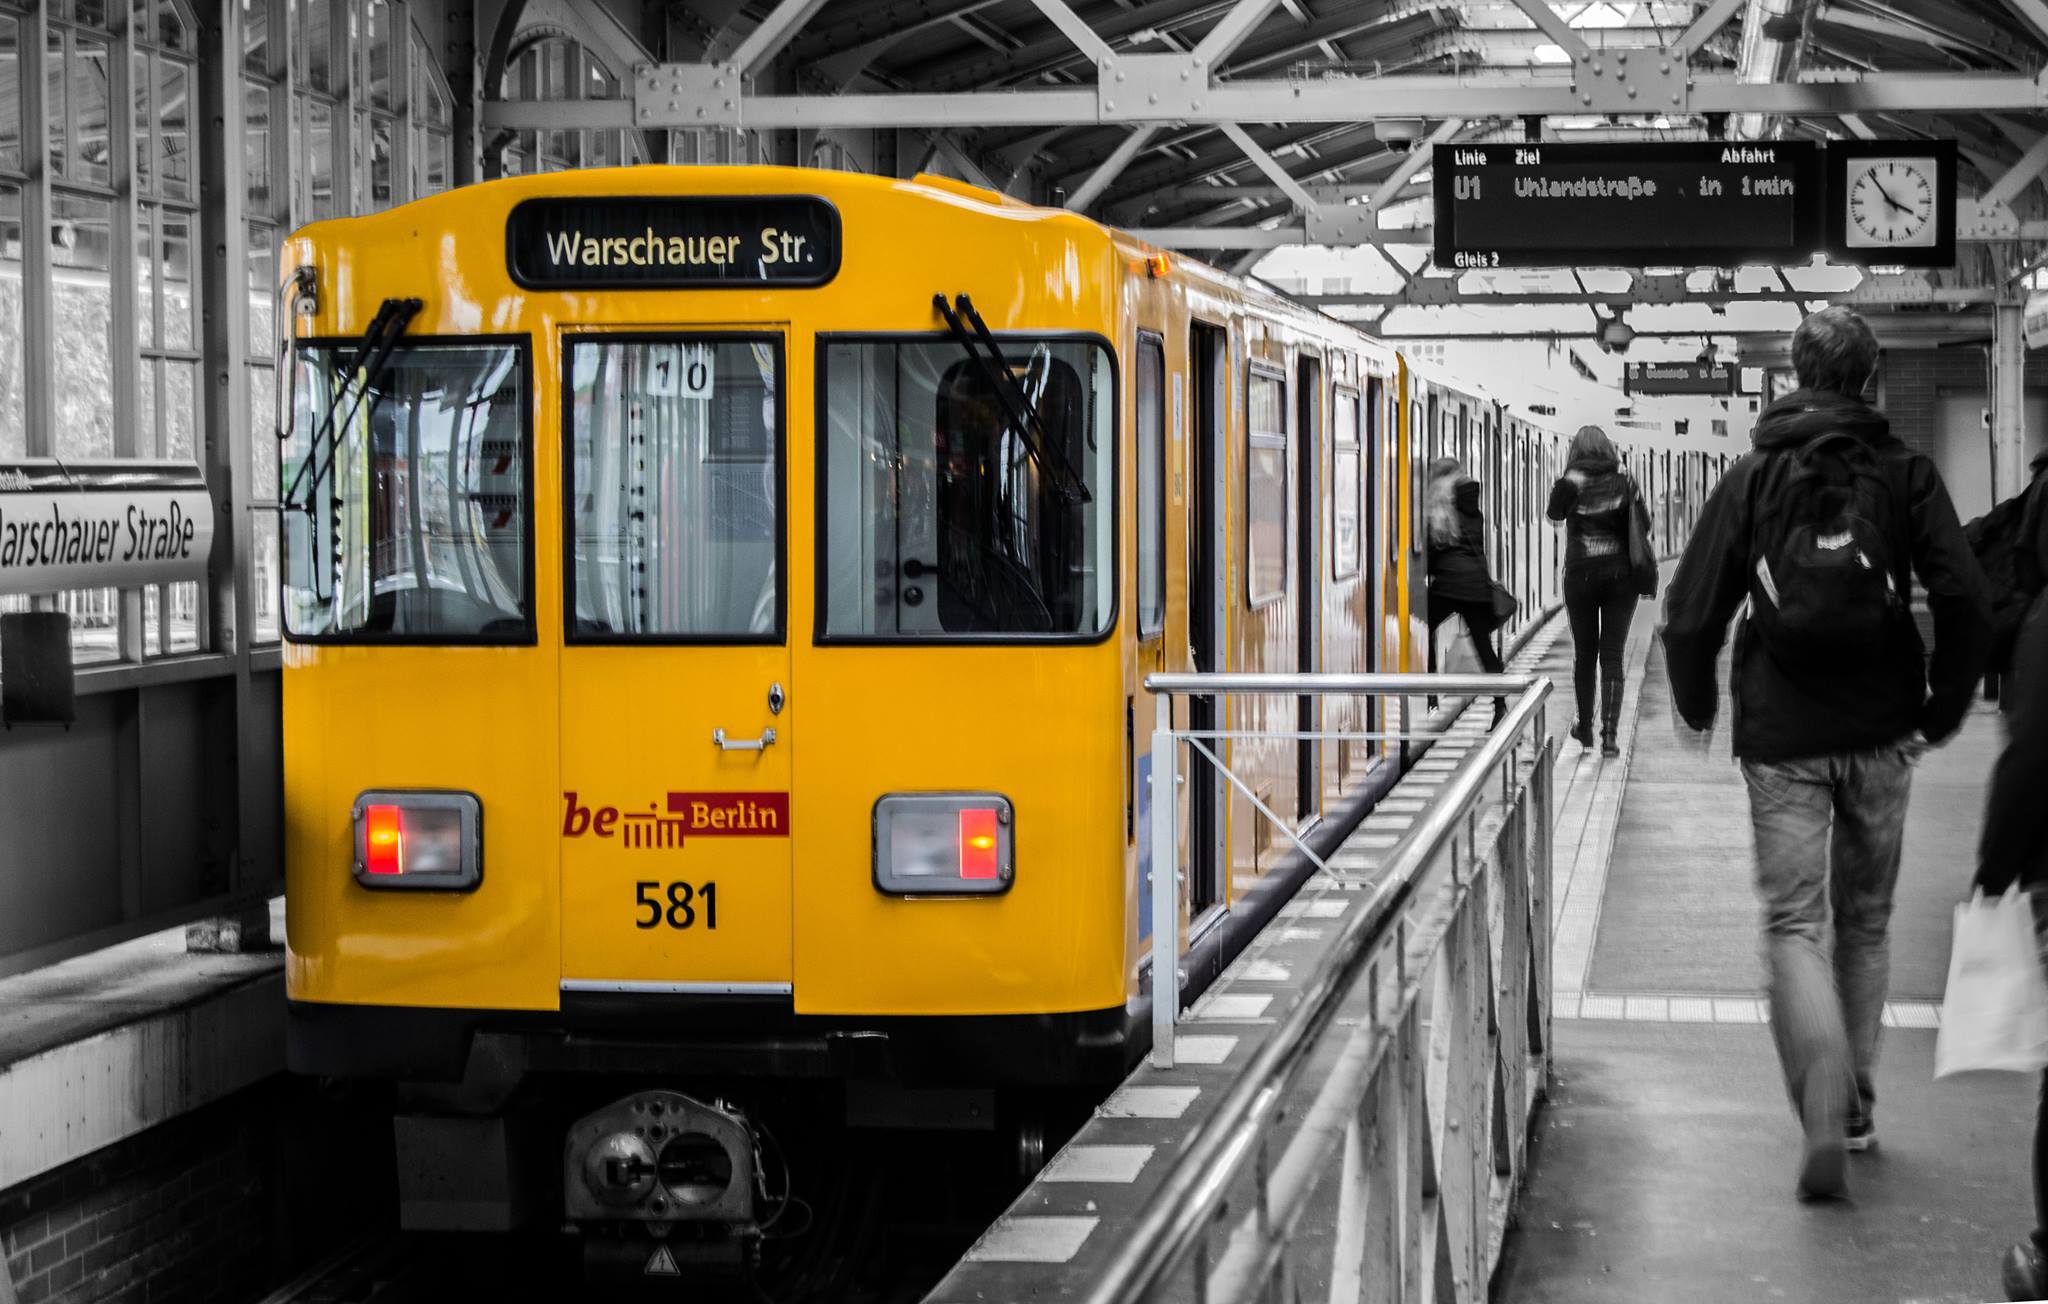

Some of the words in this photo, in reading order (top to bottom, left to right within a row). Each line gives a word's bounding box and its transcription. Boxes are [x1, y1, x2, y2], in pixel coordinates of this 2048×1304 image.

[1454, 149, 1487, 166] Linie
[1515, 148, 1541, 165] Ziel
[1721, 146, 1776, 163] Abfahrt
[1454, 175, 1481, 200] U1
[1514, 175, 1657, 201] Uhlandstraße
[1700, 175, 1722, 196] in
[547, 226, 741, 266] Warschauer
[760, 227, 814, 264] Str.
[1454, 251, 1488, 268] Gleis
[1491, 251, 1500, 268] 2
[0, 501, 120, 568] arschauer
[123, 500, 194, 561] Straße
[562, 791, 619, 838] be
[690, 801, 778, 829] Berlin
[635, 880, 717, 930] 581
